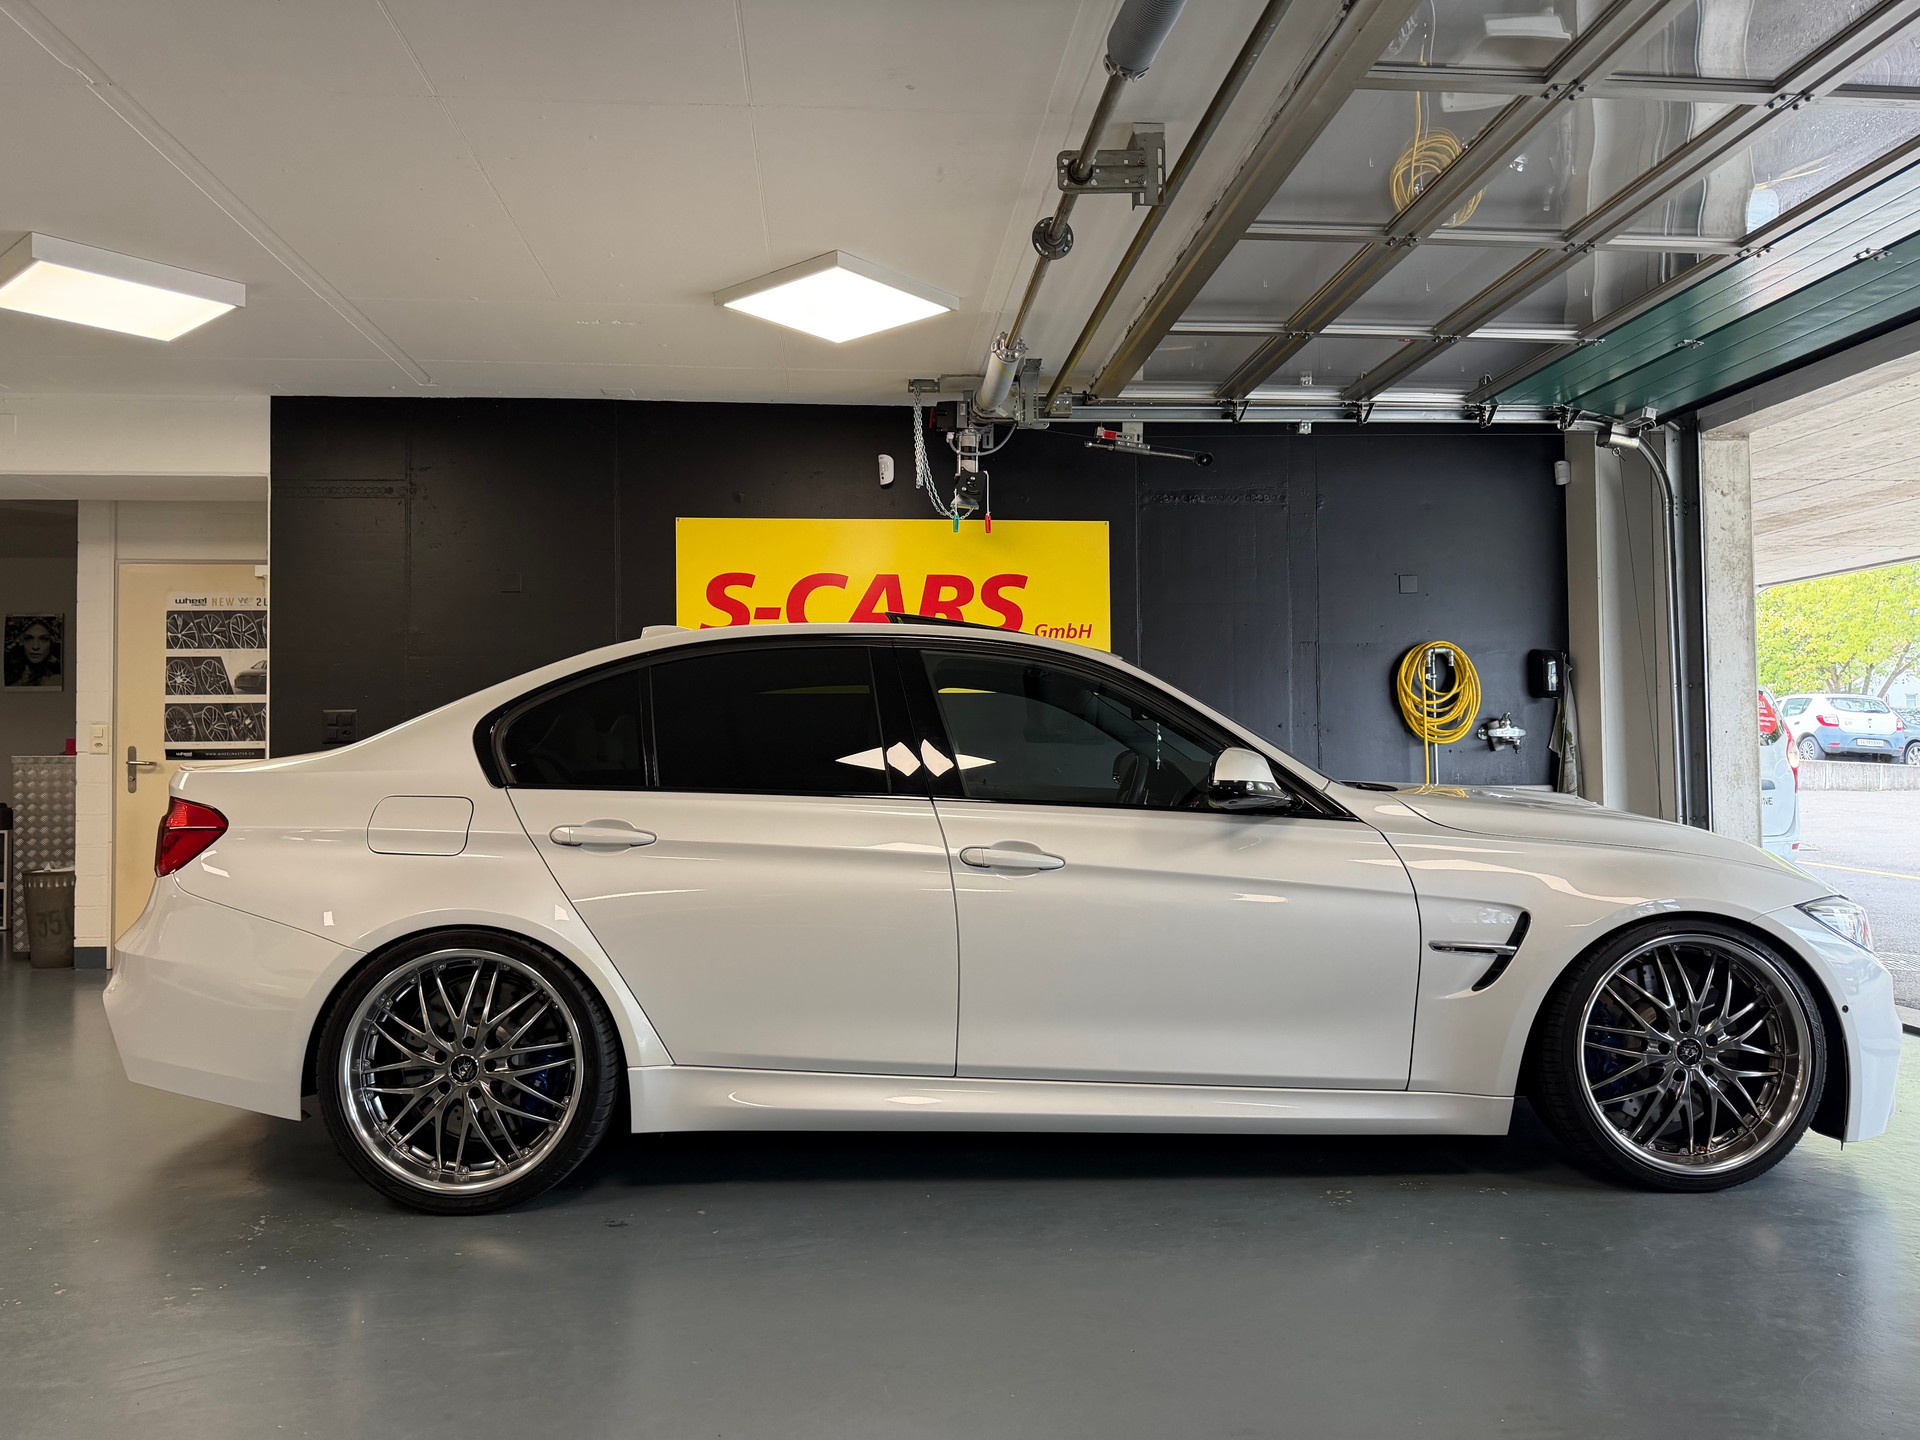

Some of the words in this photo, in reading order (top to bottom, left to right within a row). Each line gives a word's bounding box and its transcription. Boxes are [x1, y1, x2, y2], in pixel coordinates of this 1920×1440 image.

[175, 597, 207, 605] wheel
[212, 598, 235, 607] NEW
[700, 572, 1028, 632] S-CARS
[1034, 622, 1093, 639] GmbH
